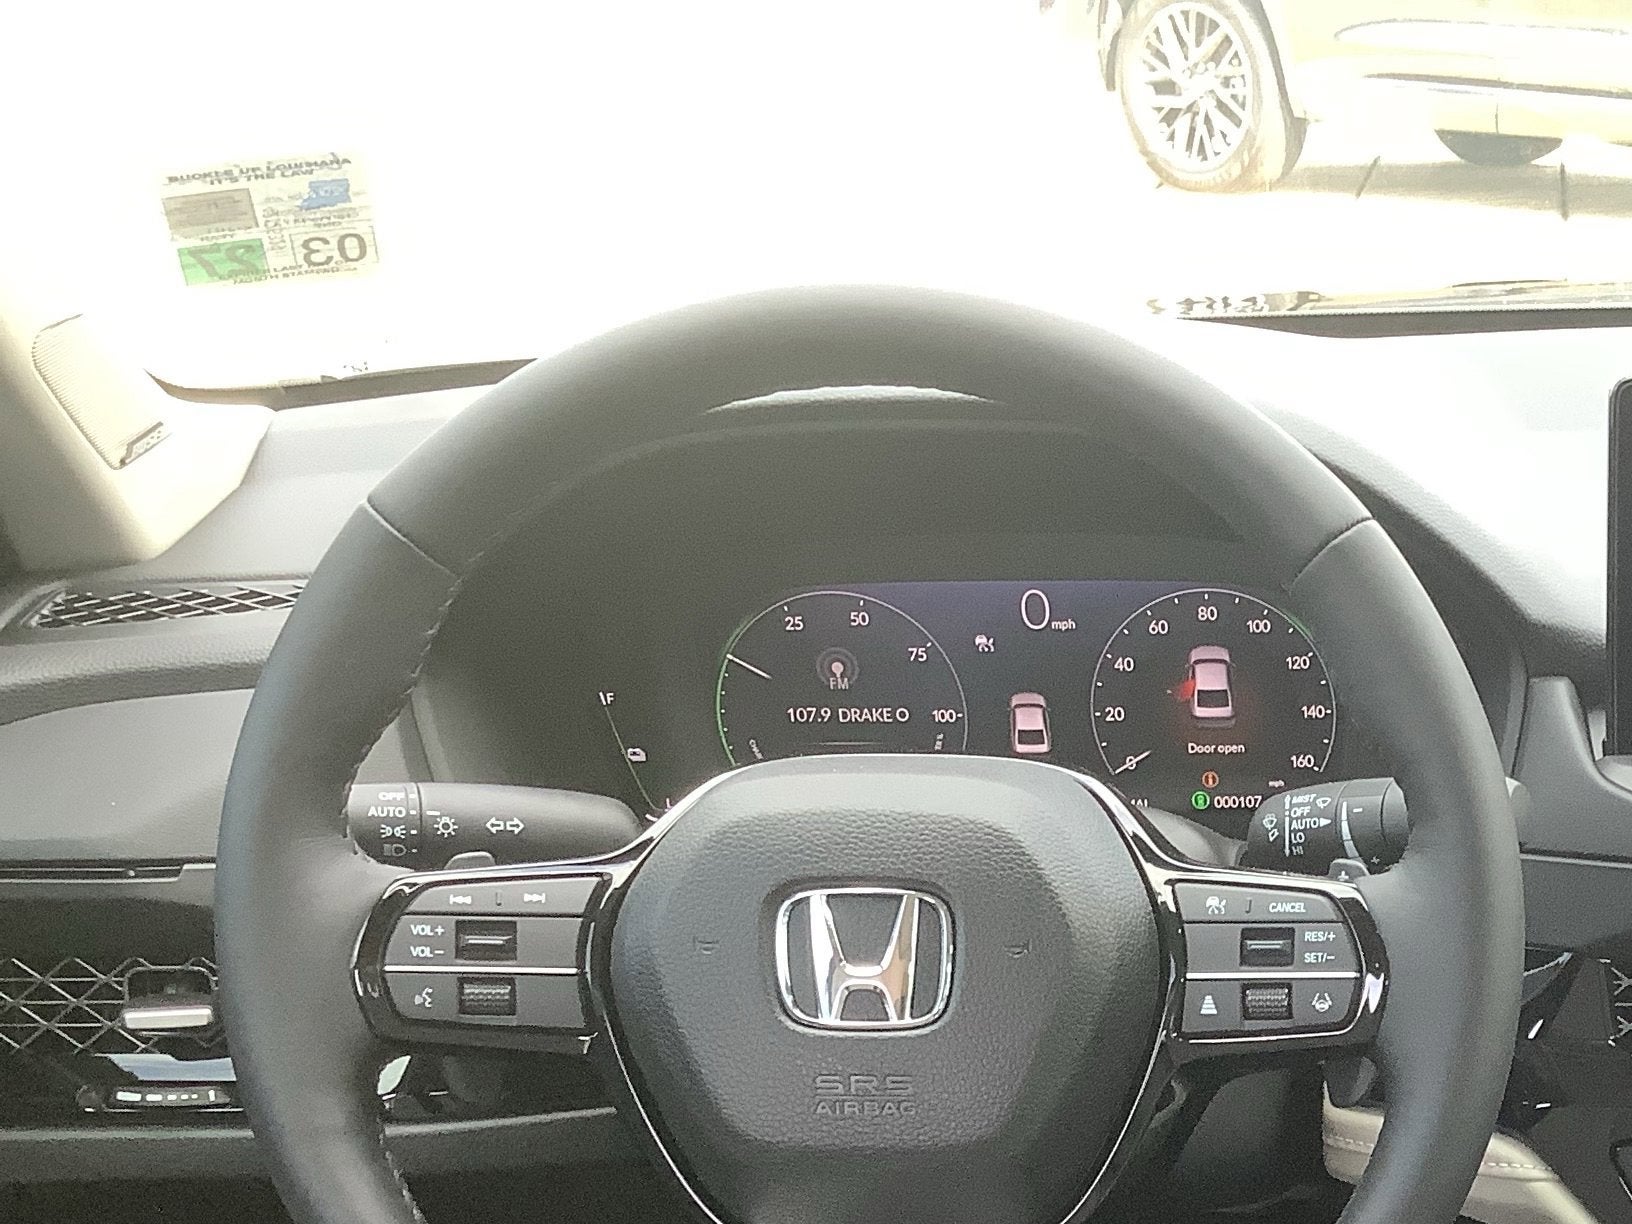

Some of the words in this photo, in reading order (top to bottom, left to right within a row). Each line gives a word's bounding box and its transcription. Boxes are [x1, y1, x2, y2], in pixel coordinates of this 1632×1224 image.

[1020, 588, 1050, 631] 0
[1051, 618, 1076, 632] mph
[1198, 606, 1218, 621] 80
[784, 616, 804, 631] 25
[850, 611, 869, 626] 50
[1148, 620, 1169, 635] 60
[1247, 619, 1271, 634] 100
[908, 647, 927, 662] 75
[1114, 657, 1134, 672] 40
[1286, 656, 1310, 670] 120
[829, 677, 849, 691] FM
[787, 707, 831, 723] 107.9
[838, 707, 893, 723] DRAKE
[895, 707, 910, 723] O
[932, 709, 956, 723] 100
[1105, 706, 1125, 721] 20
[1301, 704, 1325, 719] 140
[1188, 742, 1216, 754] Door
[1217, 744, 1245, 755] open
[1290, 754, 1314, 769] 160
[378, 790, 406, 802] OFF
[1213, 796, 1262, 809] 000107
[368, 806, 406, 818] AUTO
[1291, 806, 1310, 818] OFF
[1291, 817, 1320, 829] AUTO
[1291, 832, 1305, 843] LO
[1269, 903, 1307, 913] CANCEL
[814, 1074, 914, 1096] SRS
[814, 1101, 917, 1117] AIRBAG
